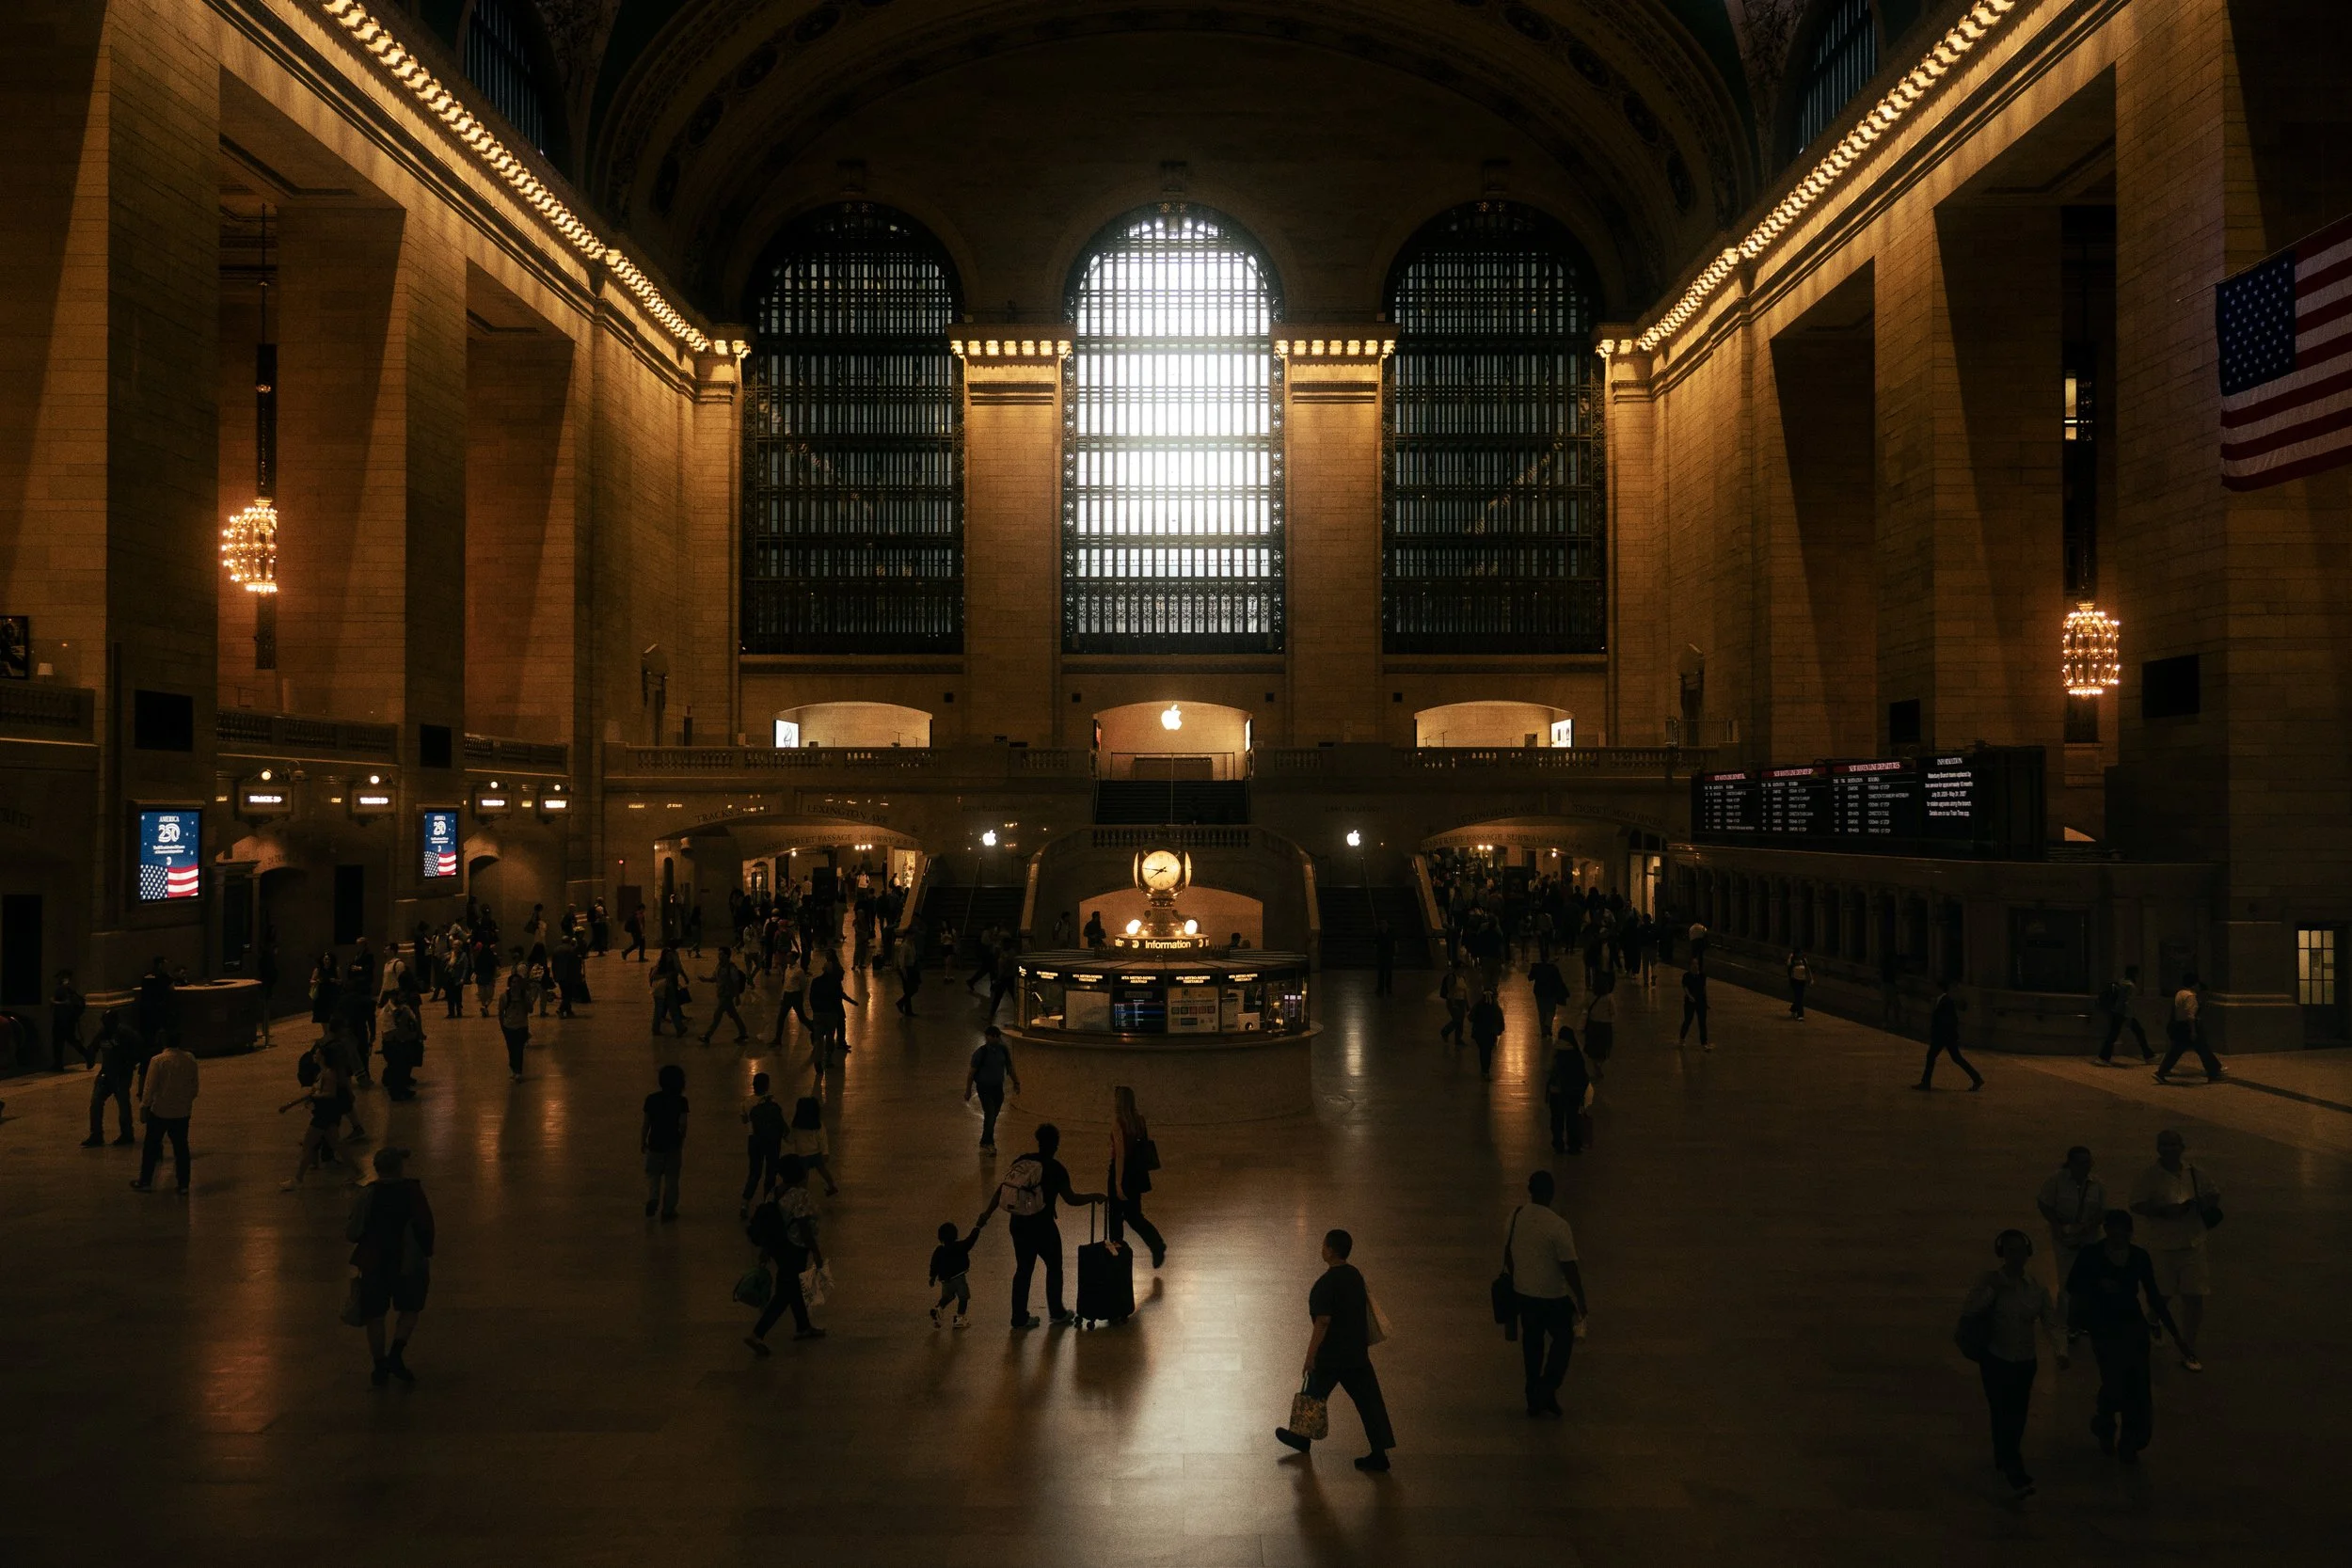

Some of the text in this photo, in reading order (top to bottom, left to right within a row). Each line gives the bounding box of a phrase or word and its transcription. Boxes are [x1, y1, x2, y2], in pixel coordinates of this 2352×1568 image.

[696, 808, 734, 822] TRACKS
[807, 804, 866, 819] LEXINGTON
[158, 823, 181, 843] 250
[817, 834, 850, 843] PASSAGE
[1145, 939, 1191, 949] Information
